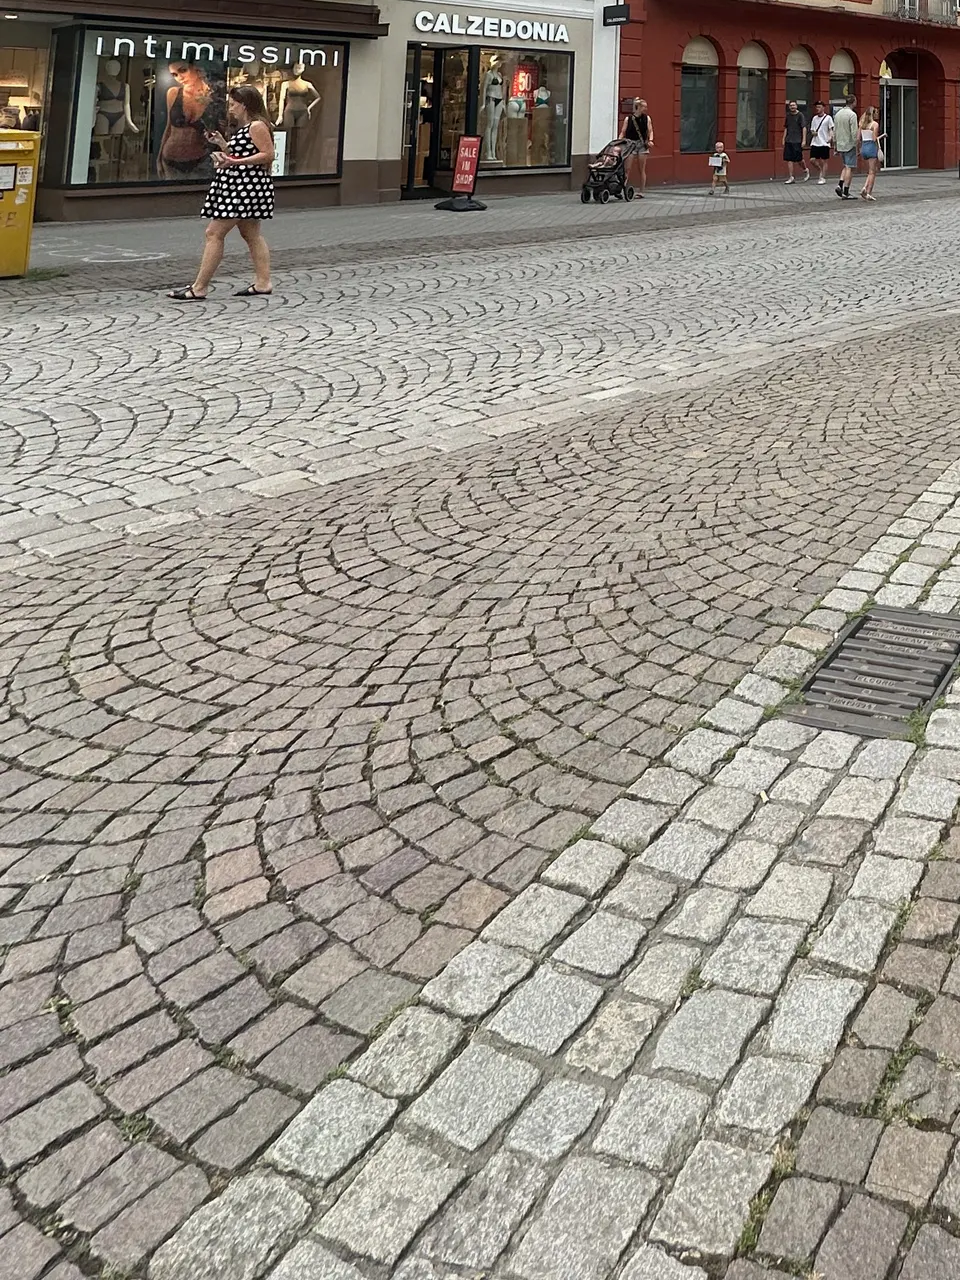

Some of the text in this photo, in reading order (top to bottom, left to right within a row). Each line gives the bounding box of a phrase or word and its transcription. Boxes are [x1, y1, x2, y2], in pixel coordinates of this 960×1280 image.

[415, 10, 570, 43] CALZEDONIA
[96, 35, 340, 67] intimissimi
[460, 147, 477, 158] SALE
[461, 161, 471, 171] IM
[455, 173, 473, 185] SHOP
